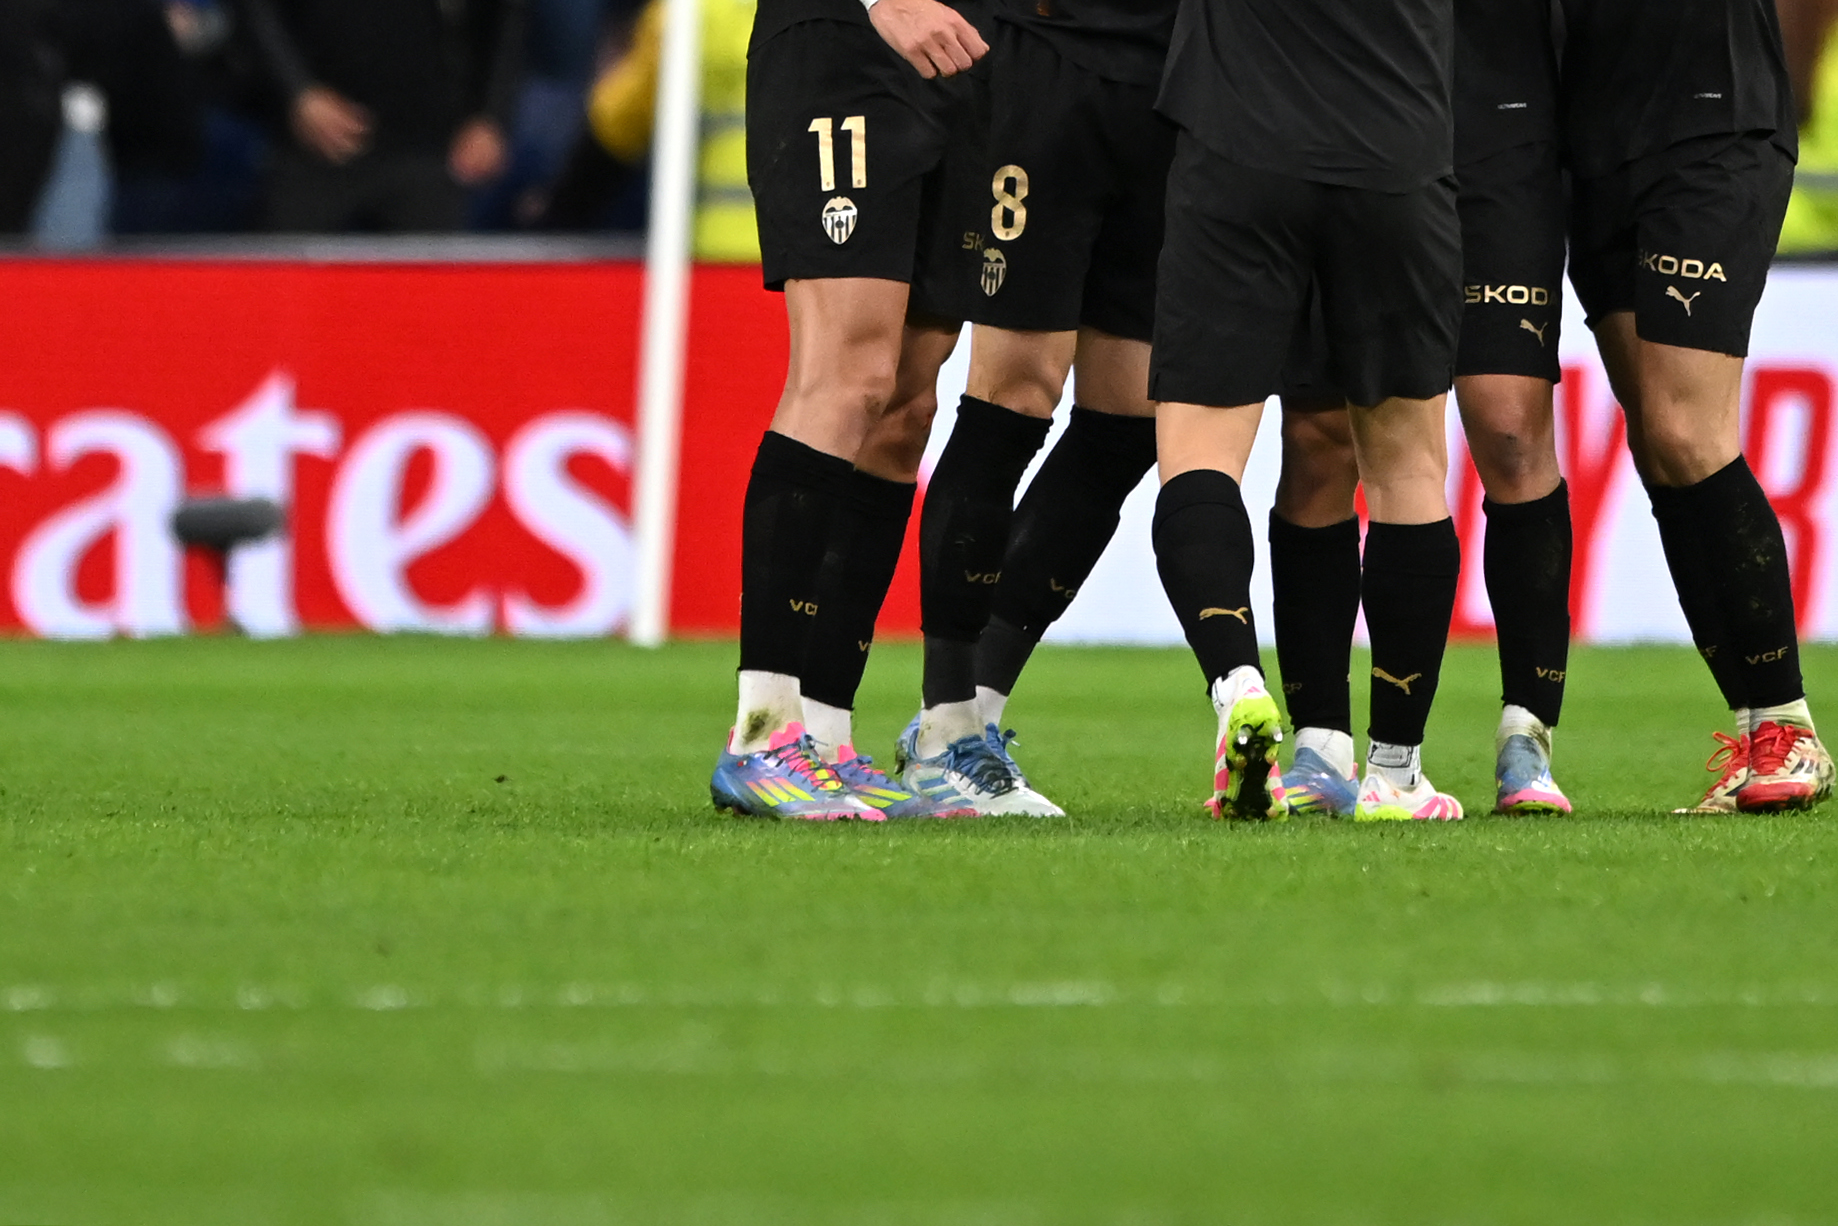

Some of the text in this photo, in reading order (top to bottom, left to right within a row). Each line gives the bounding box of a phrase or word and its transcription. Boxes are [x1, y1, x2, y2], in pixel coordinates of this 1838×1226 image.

[807, 115, 867, 192] 11
[991, 164, 1029, 241] 8
[1744, 645, 1789, 665] VCF
